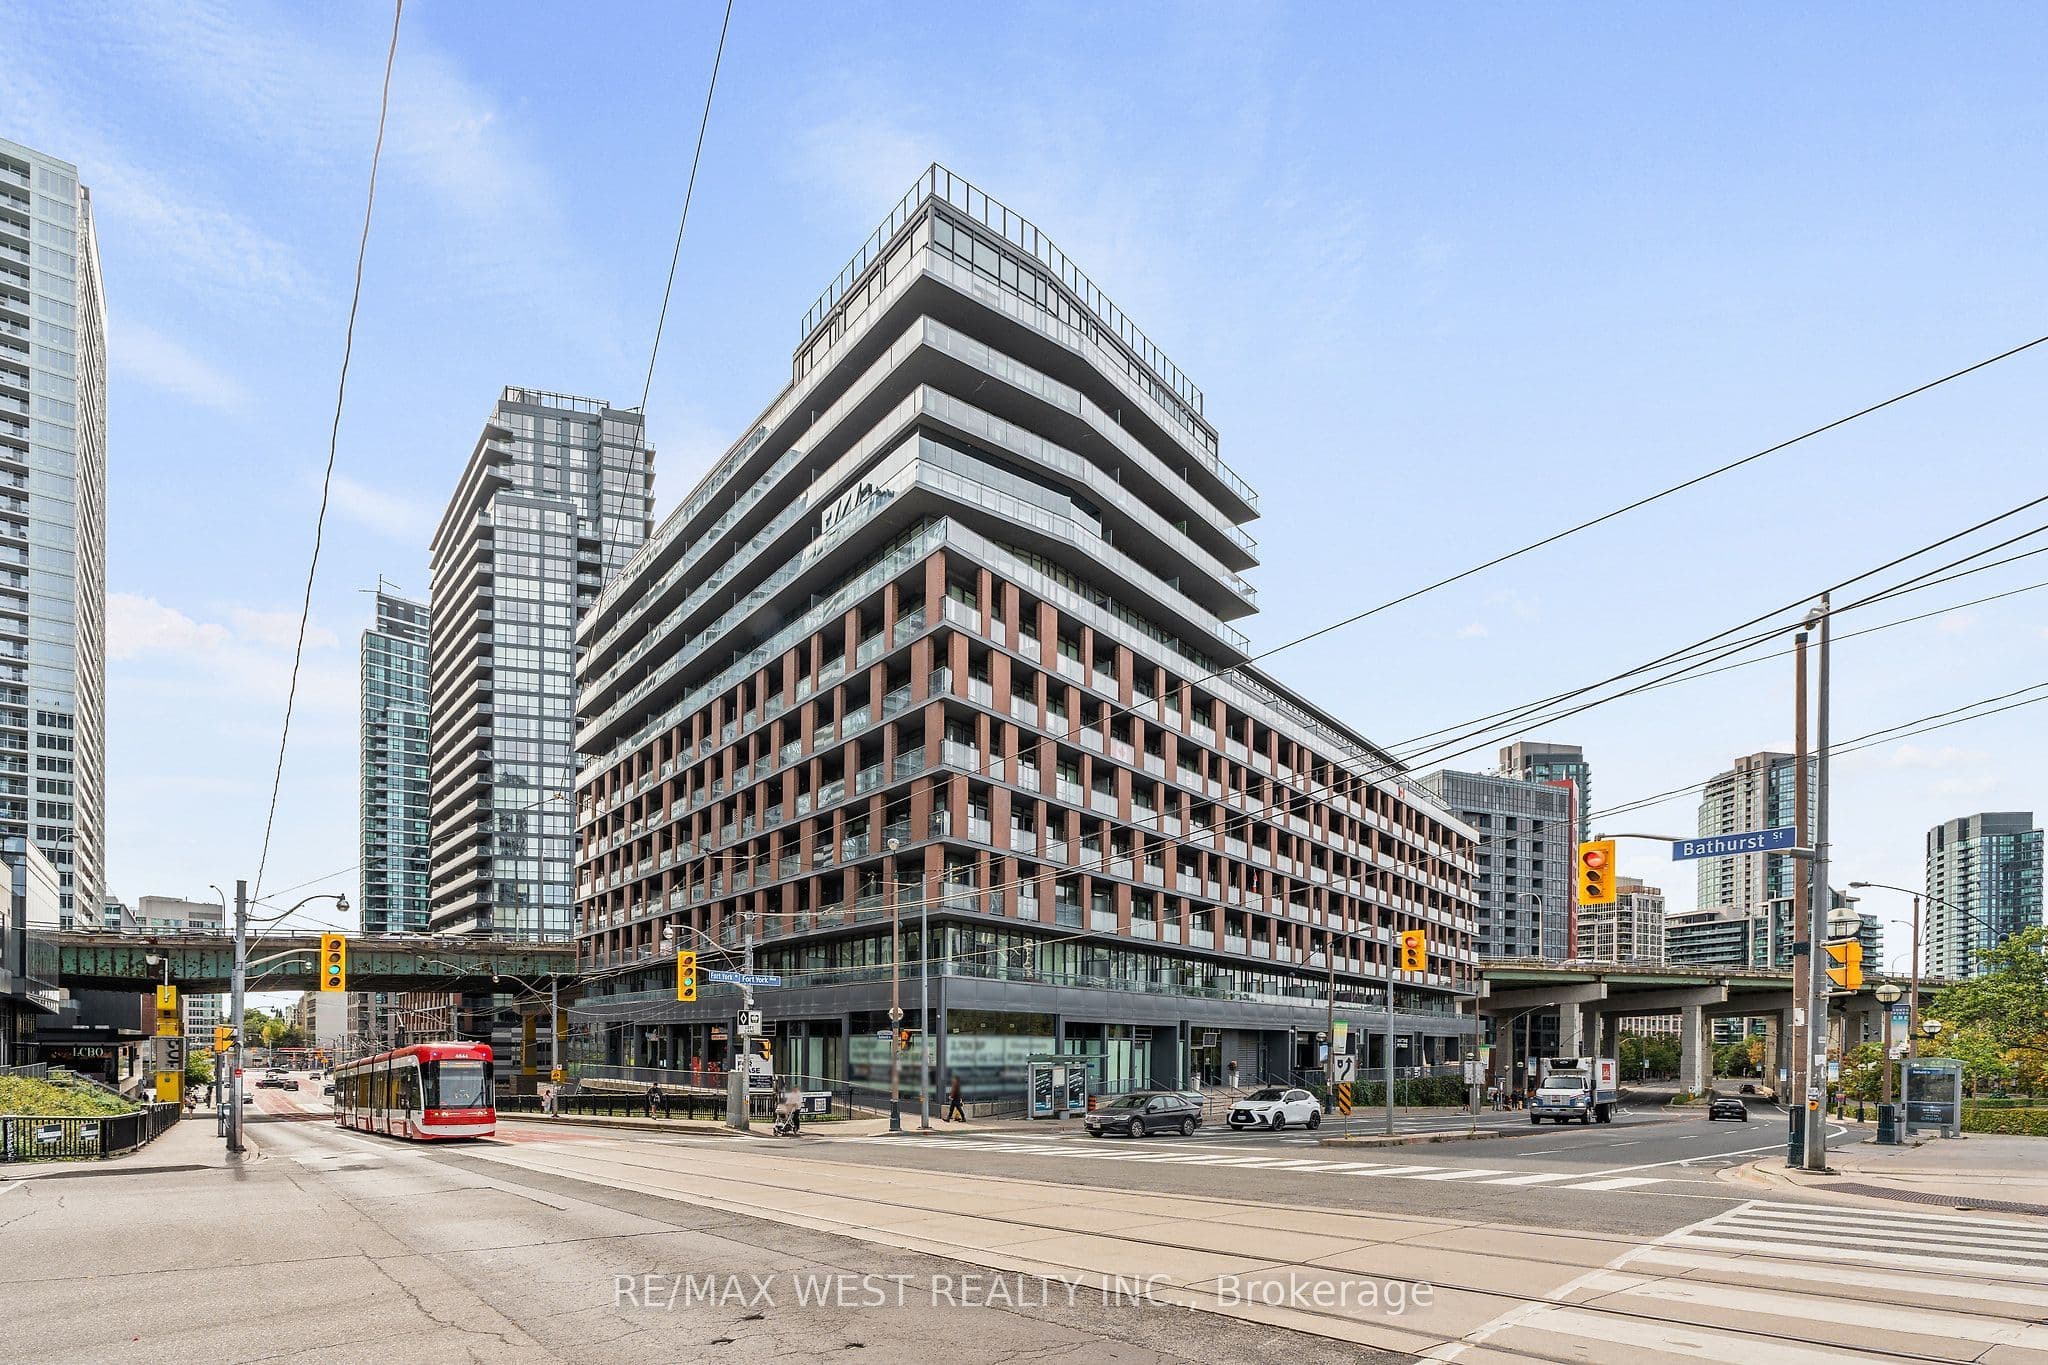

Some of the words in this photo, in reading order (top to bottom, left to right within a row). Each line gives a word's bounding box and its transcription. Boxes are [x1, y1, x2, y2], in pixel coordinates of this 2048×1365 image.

[1683, 834, 1765, 856] Bathurst
[1772, 831, 1783, 841] St
[710, 972, 721, 980] Fort
[722, 973, 733, 981] York
[755, 976, 769, 984] York
[73, 1047, 104, 1058] LCBO
